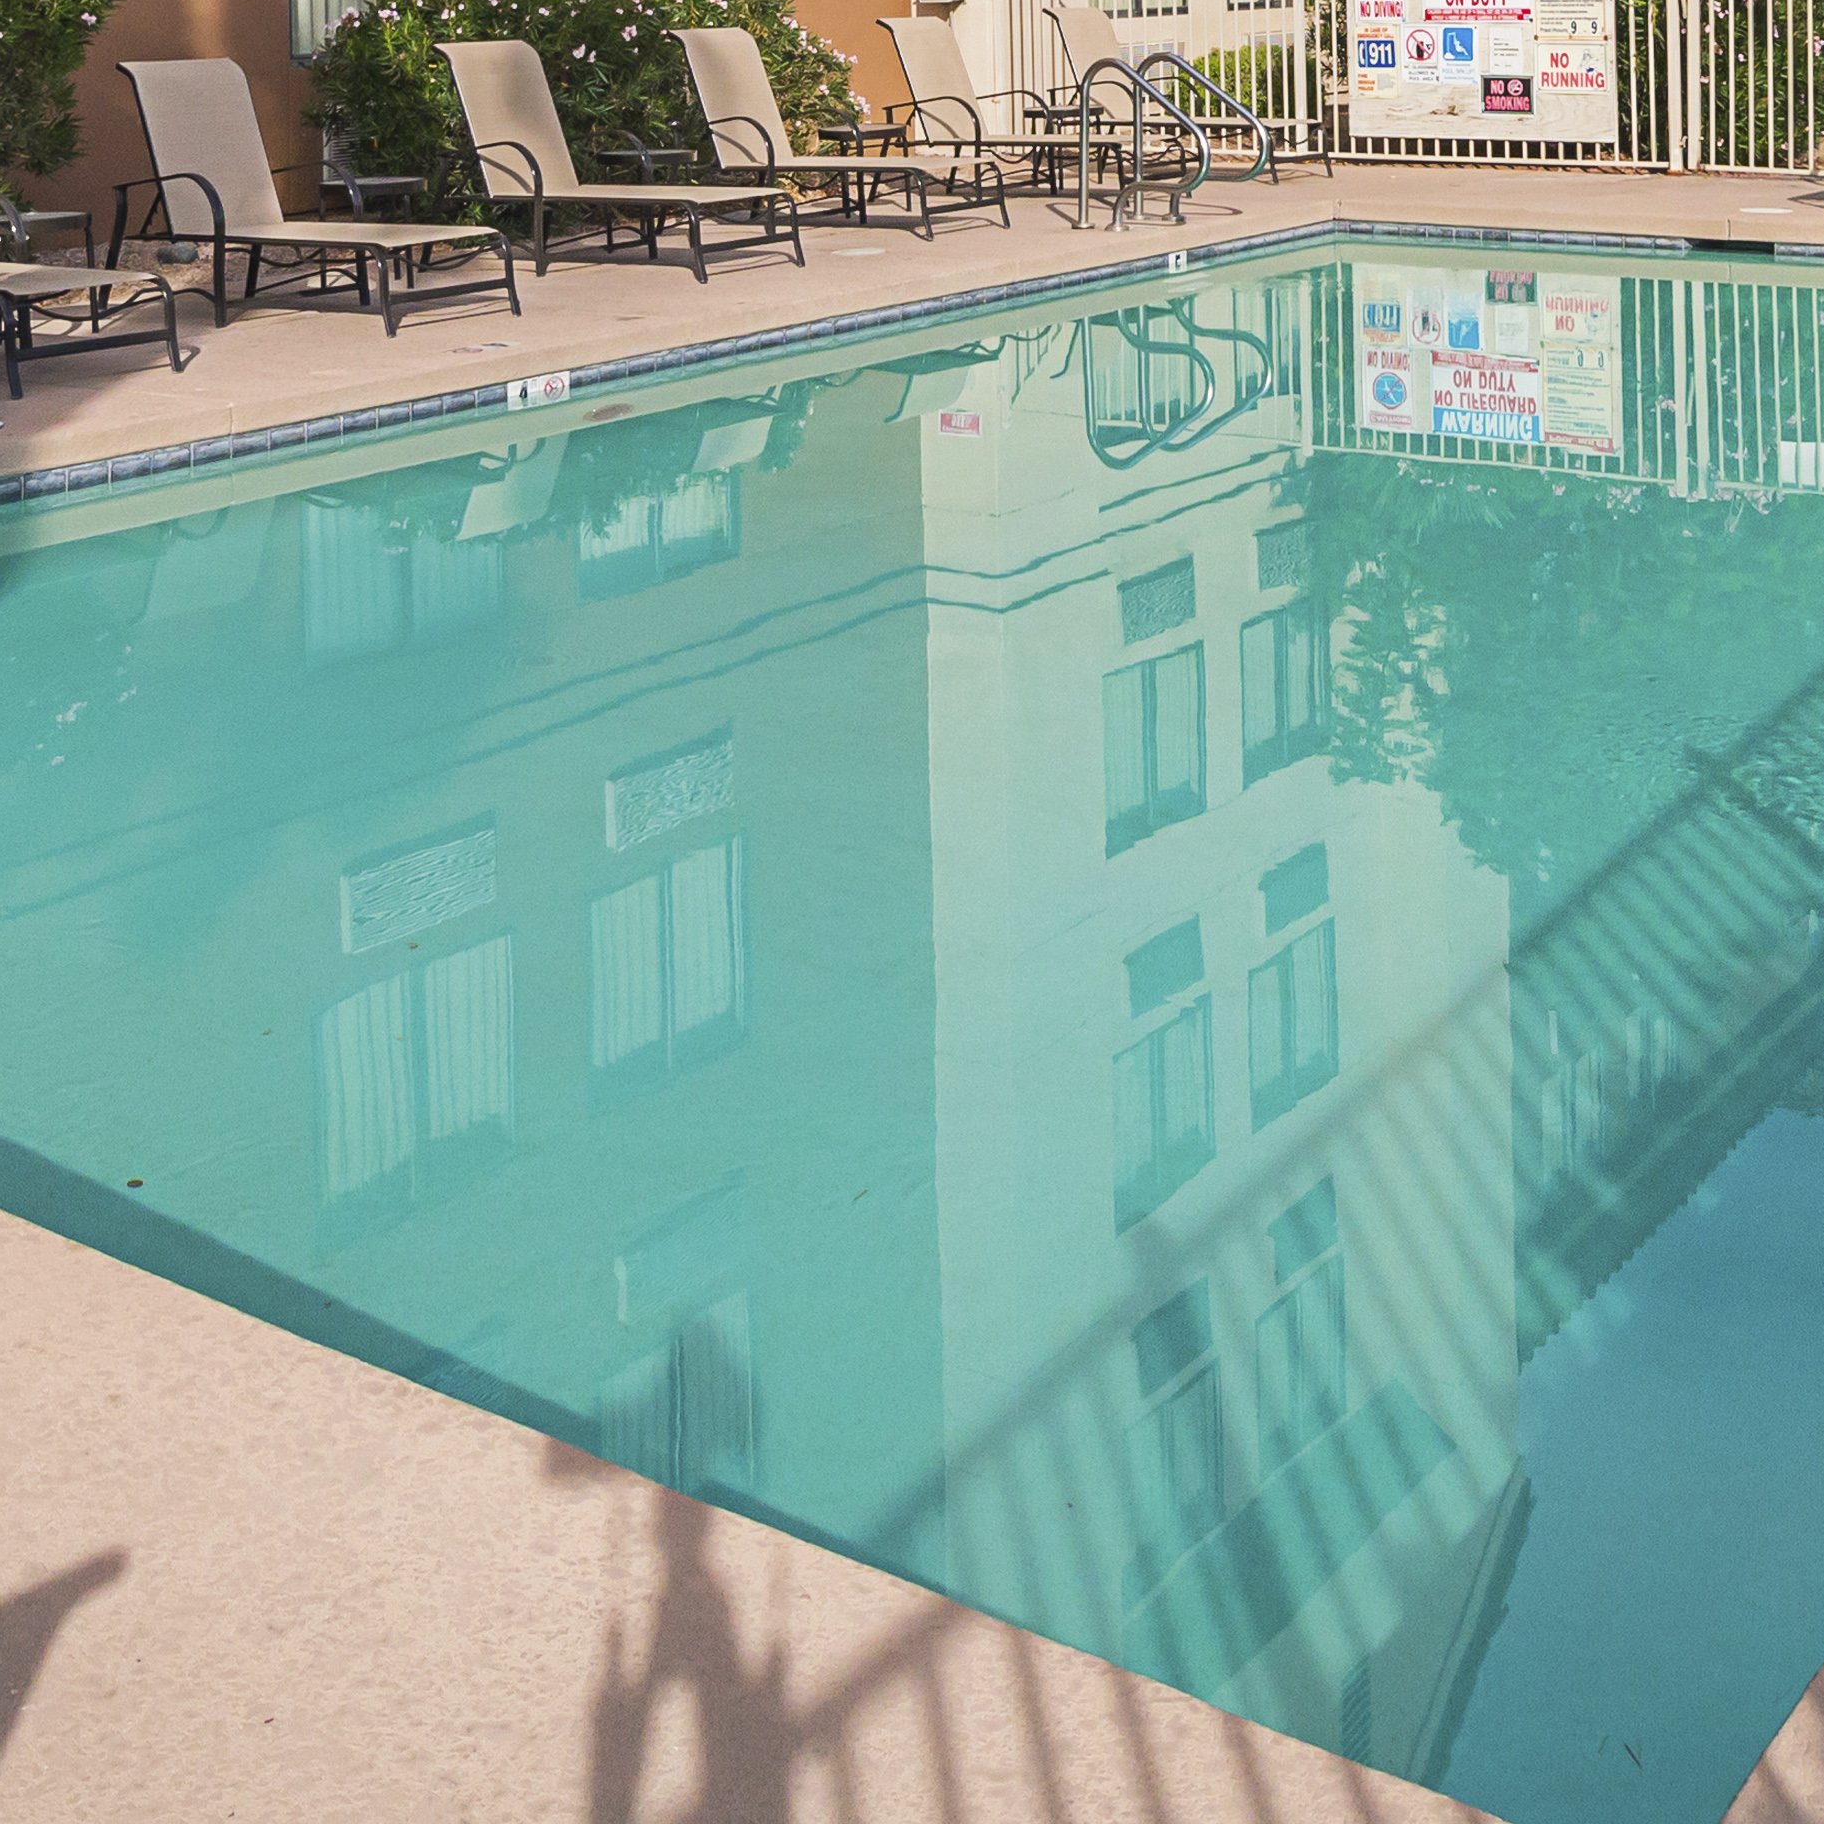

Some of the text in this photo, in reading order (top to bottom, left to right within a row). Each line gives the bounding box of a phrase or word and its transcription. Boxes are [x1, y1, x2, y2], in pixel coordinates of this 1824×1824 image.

[1360, 0, 1404, 17] NO DIVING!
[1570, 20, 1577, 34] 9
[1591, 20, 1598, 34] 9
[1368, 42, 1393, 65] 911
[1550, 53, 1569, 68] NO
[1490, 80, 1505, 94] NO
[1541, 72, 1605, 88] RUNNING
[1485, 96, 1530, 111] SMOKING
